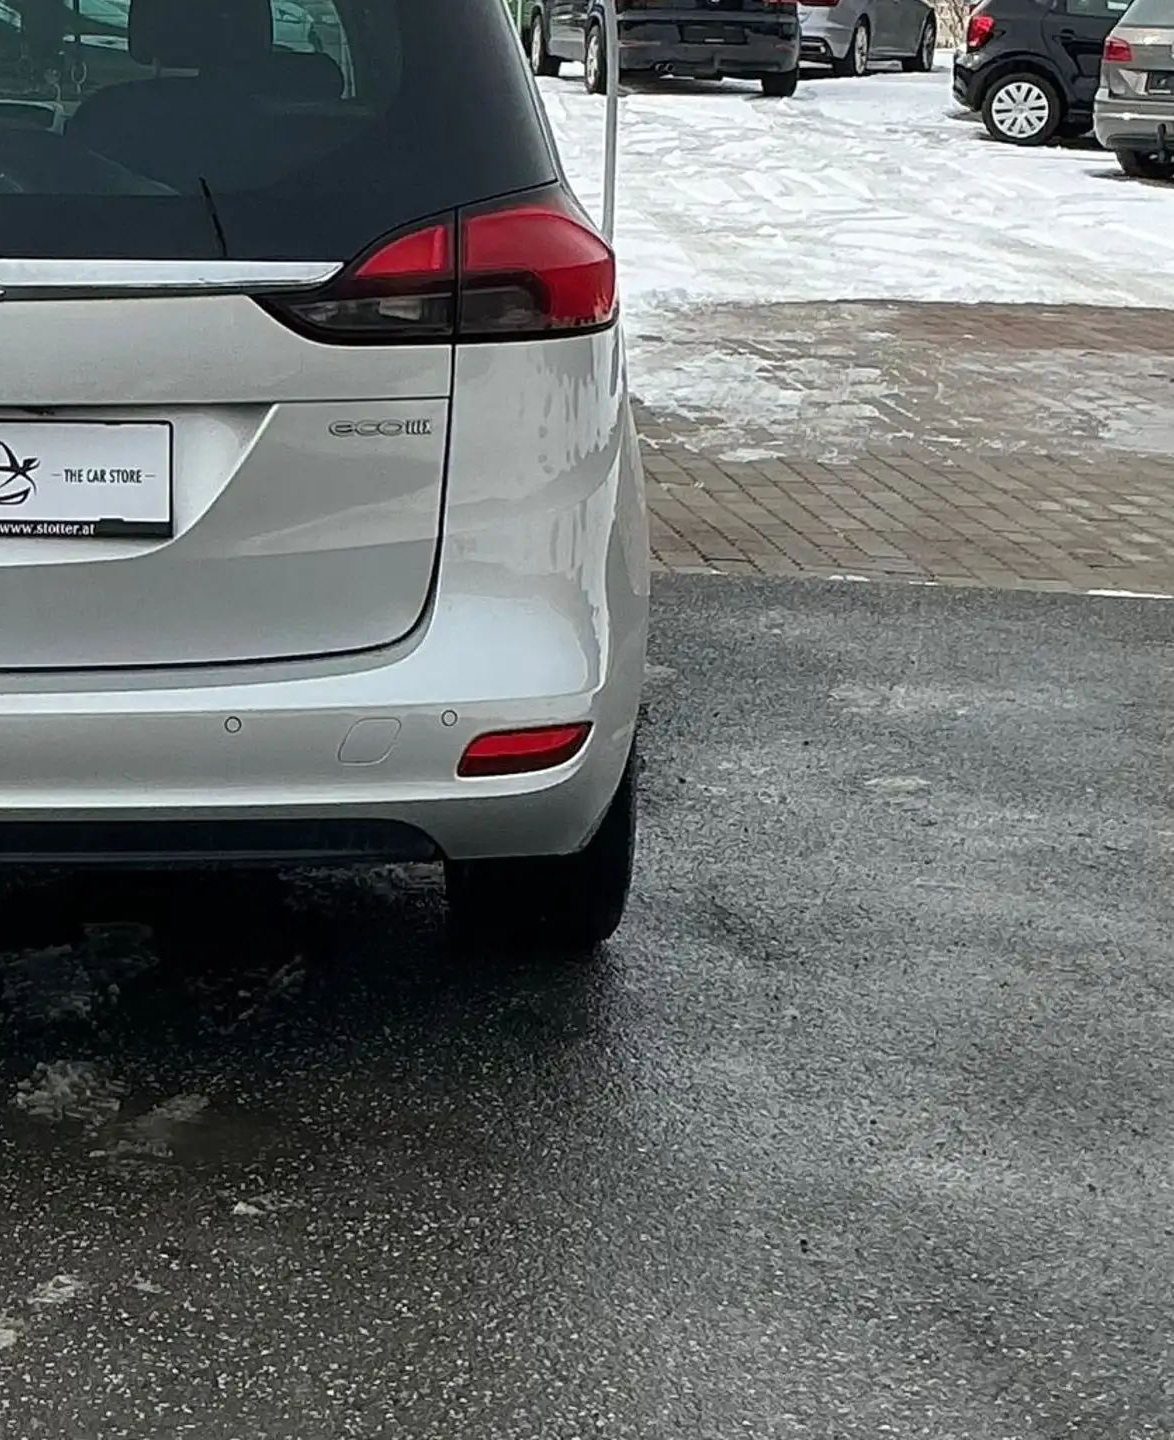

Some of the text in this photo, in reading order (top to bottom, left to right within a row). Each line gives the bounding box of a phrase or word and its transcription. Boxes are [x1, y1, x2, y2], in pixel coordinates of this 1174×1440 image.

[64, 468, 142, 484] THE CAR STORE
[0, 522, 95, 536] www.stotter.at
